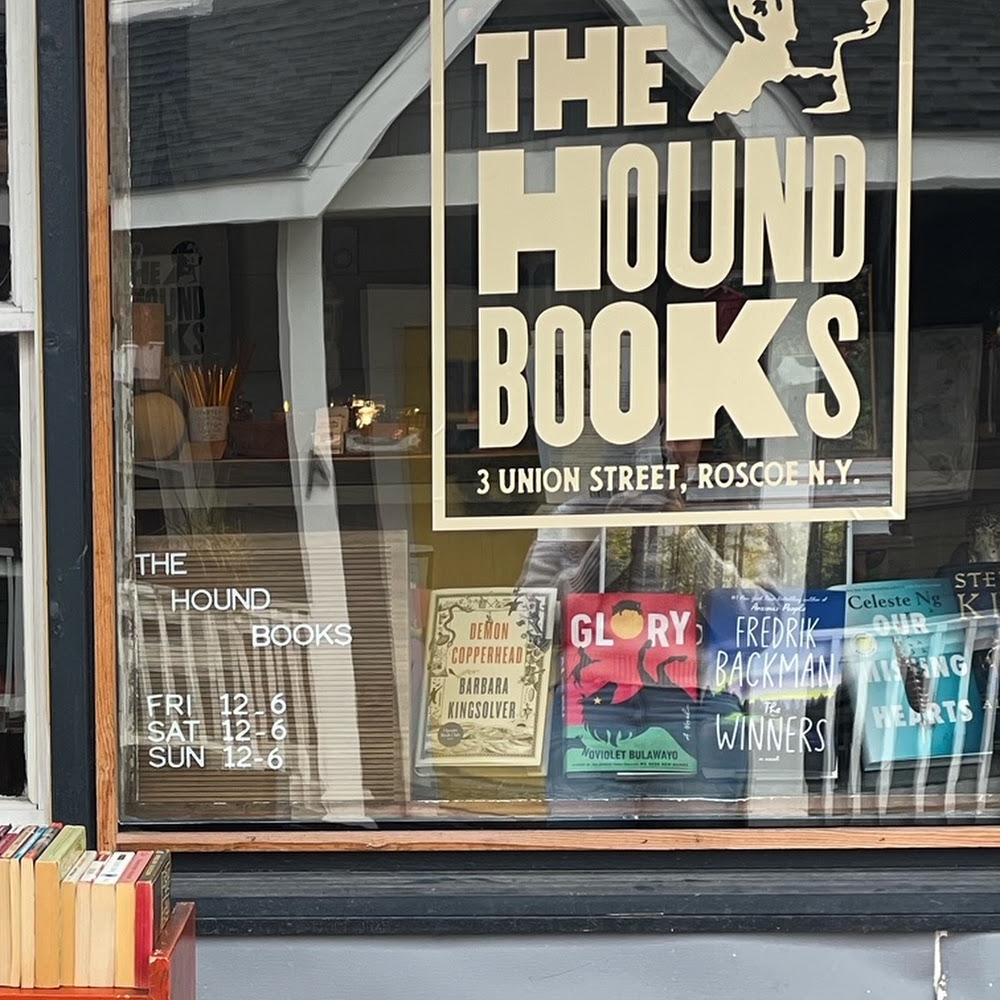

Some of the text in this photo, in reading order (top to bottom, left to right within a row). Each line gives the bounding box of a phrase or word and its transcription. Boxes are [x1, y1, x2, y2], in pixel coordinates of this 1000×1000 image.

[474, 25, 668, 134] THE
[477, 134, 866, 296] HOUND
[478, 294, 860, 449] BOOKS
[476, 458, 862, 496] 3 UNION STREET, ROSCOE N.Y.
[135, 553, 187, 575] THE
[954, 571, 1000, 589] STE
[171, 588, 271, 611] HOUND
[848, 592, 911, 610] Celeste
[915, 591, 943, 609] Ng
[469, 622, 509, 640] DEMON
[570, 609, 691, 648] GLORY
[736, 615, 820, 649] FREDRIK
[873, 612, 930, 636] OUR
[251, 624, 352, 648] BOOKS
[451, 646, 523, 665] COPPERHEAD
[715, 650, 835, 689] BACKMAN
[459, 677, 509, 695] BARBARA
[147, 694, 192, 717] FRI
[448, 701, 516, 719] KINGSOLVER
[764, 702, 781, 715] The
[872, 699, 973, 729] HEARTS
[147, 720, 200, 743] SAT
[716, 713, 828, 753] WINNERS
[149, 746, 205, 769] SUN
[629, 750, 679, 760] BULAWAYO
